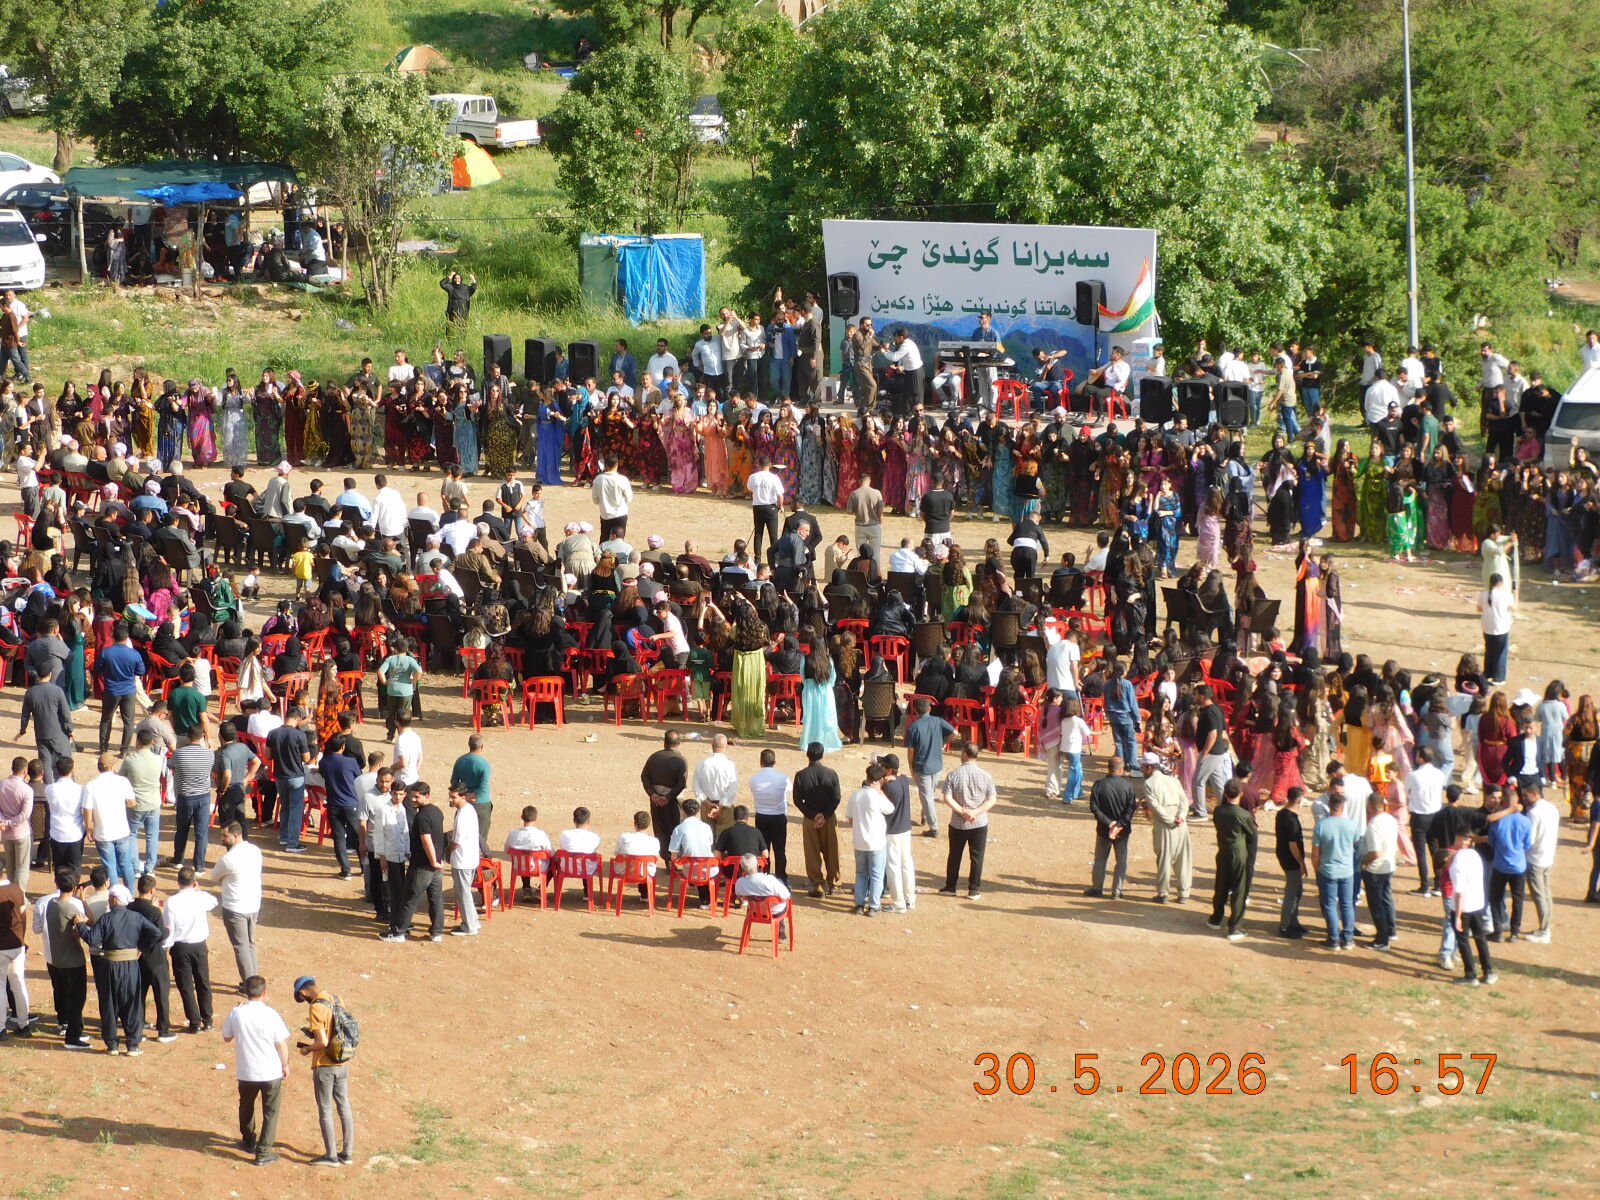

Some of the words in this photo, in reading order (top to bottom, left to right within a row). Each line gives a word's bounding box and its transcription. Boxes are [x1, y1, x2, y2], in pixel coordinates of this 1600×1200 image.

[867, 239, 908, 275] چێ
[921, 236, 1000, 272] گوندێ
[1012, 240, 1110, 275] سەیرانا
[870, 295, 915, 314] دکەین
[1034, 300, 1078, 320] رهاتنا
